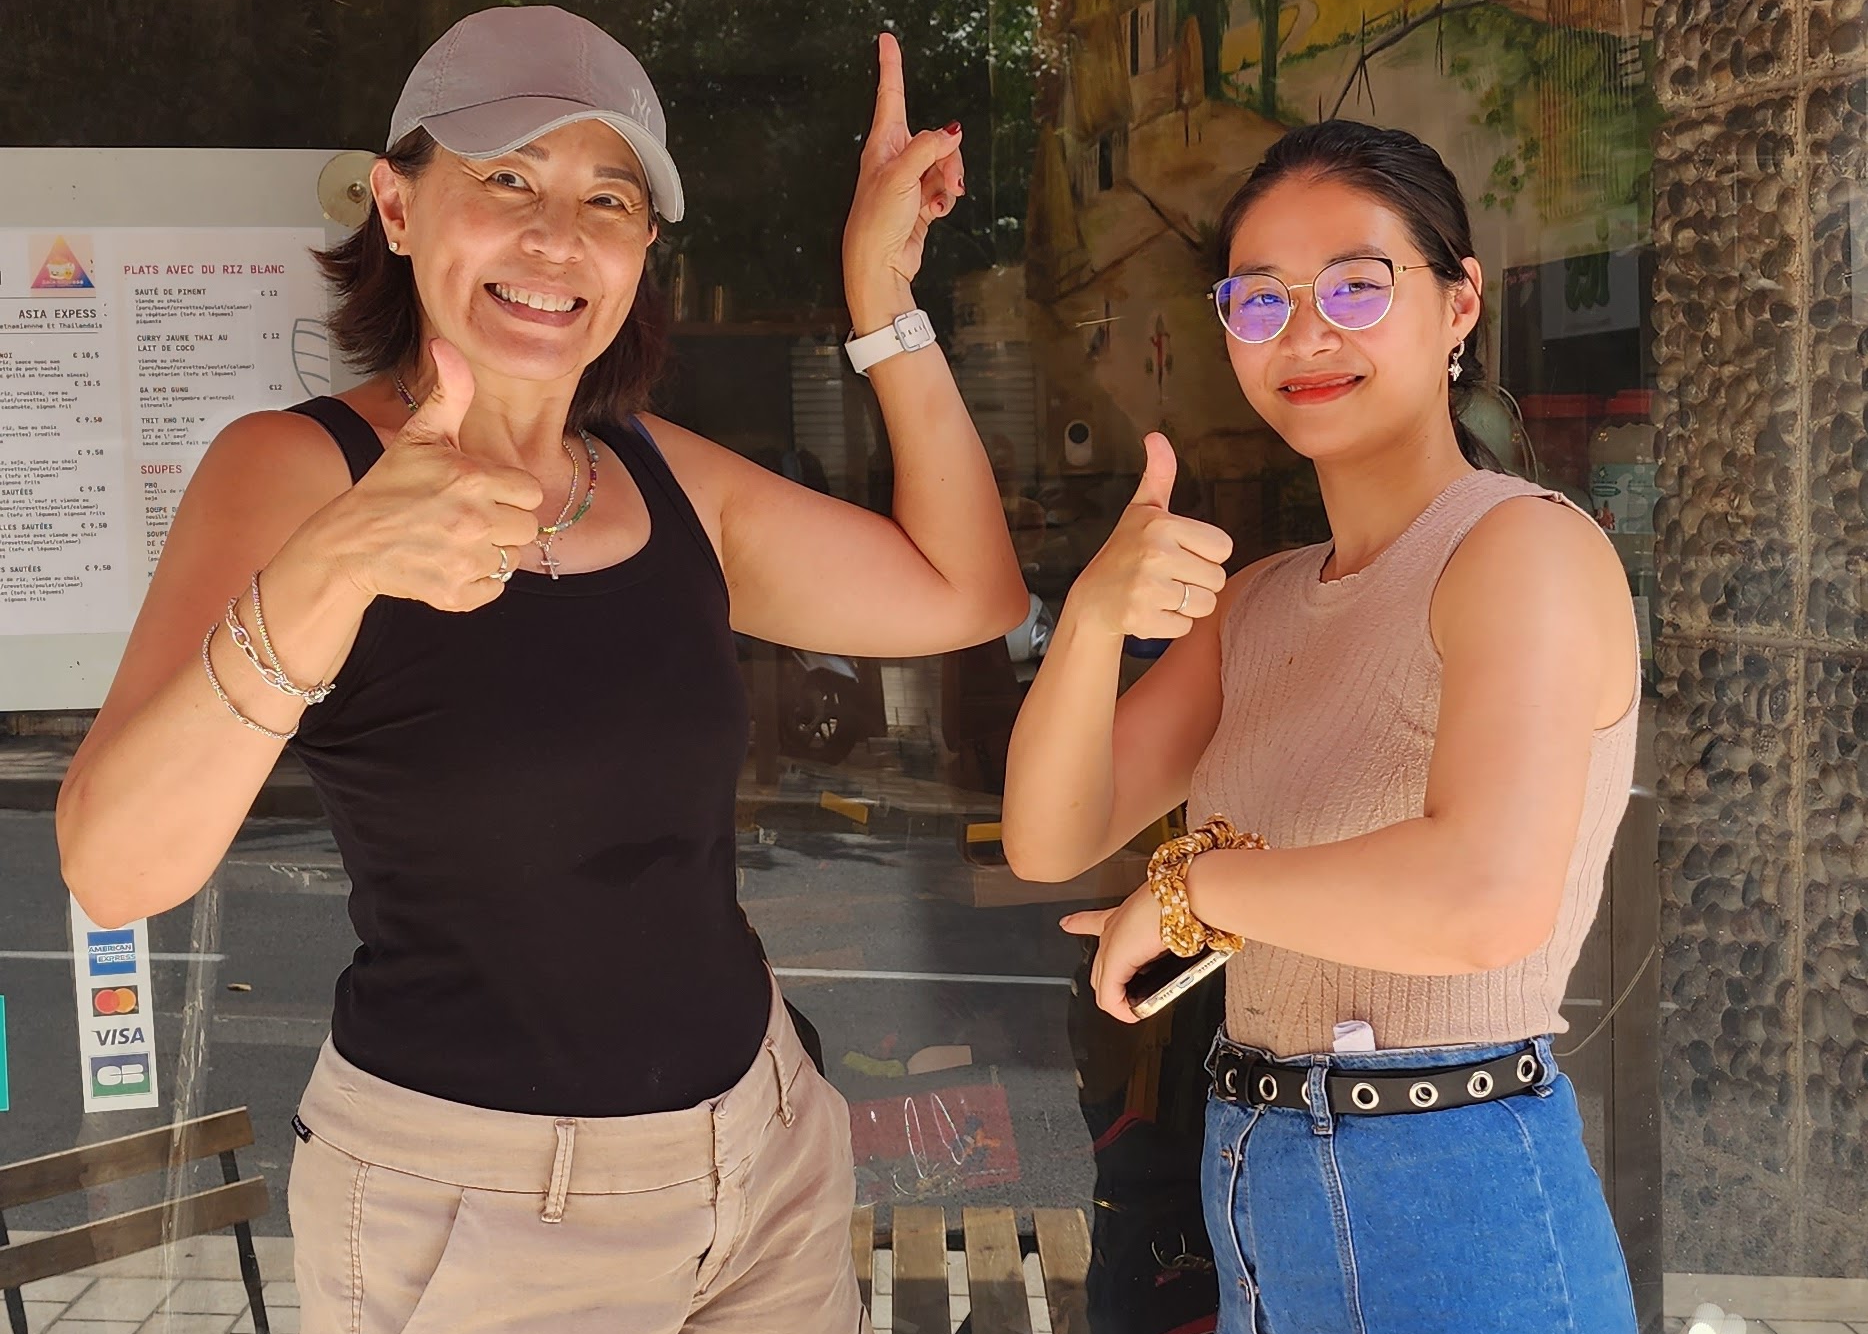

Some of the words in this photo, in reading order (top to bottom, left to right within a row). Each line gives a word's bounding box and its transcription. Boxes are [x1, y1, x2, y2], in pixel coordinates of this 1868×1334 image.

[124, 265, 159, 274] PLATS
[166, 265, 194, 274] AVEC
[201, 265, 215, 274] DU
[222, 265, 243, 274] RIZ
[250, 265, 285, 274] BLANC
[19, 310, 47, 319] ASIA
[54, 309, 97, 318] EXPESS
[140, 465, 183, 474] SOUPES
[88, 944, 132, 953] AMERICAN
[98, 954, 136, 963] EXPRESS
[91, 1027, 145, 1046] VISA
